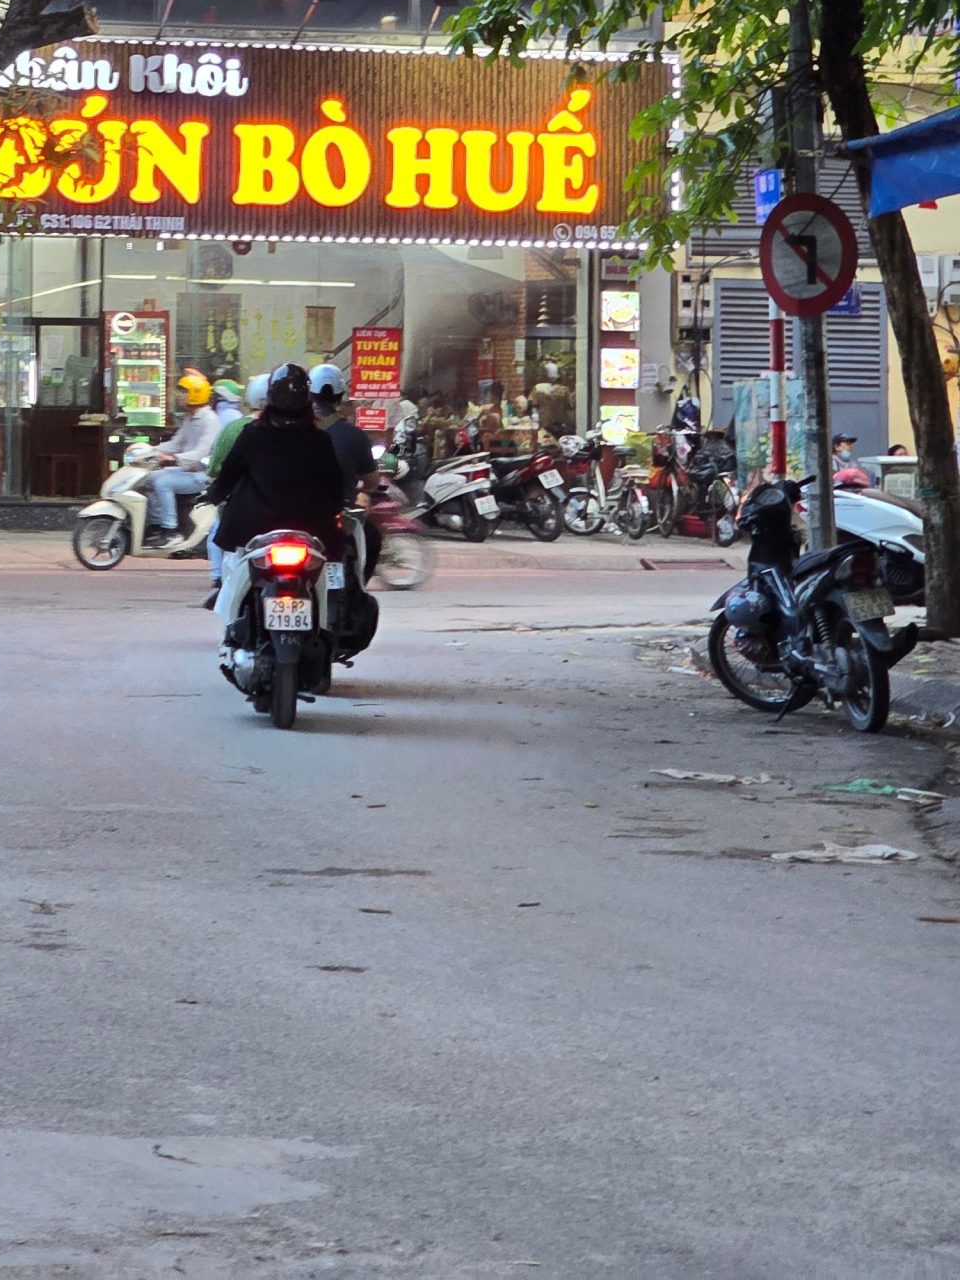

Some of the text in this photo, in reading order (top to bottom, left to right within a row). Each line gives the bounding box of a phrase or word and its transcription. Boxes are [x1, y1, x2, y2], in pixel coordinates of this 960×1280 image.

[128, 52, 249, 97] Khôi
[232, 99, 372, 207] BÒ
[385, 89, 599, 214] HUẾ
[575, 225, 598, 239] 094
[268, 614, 308, 627] 219.84
